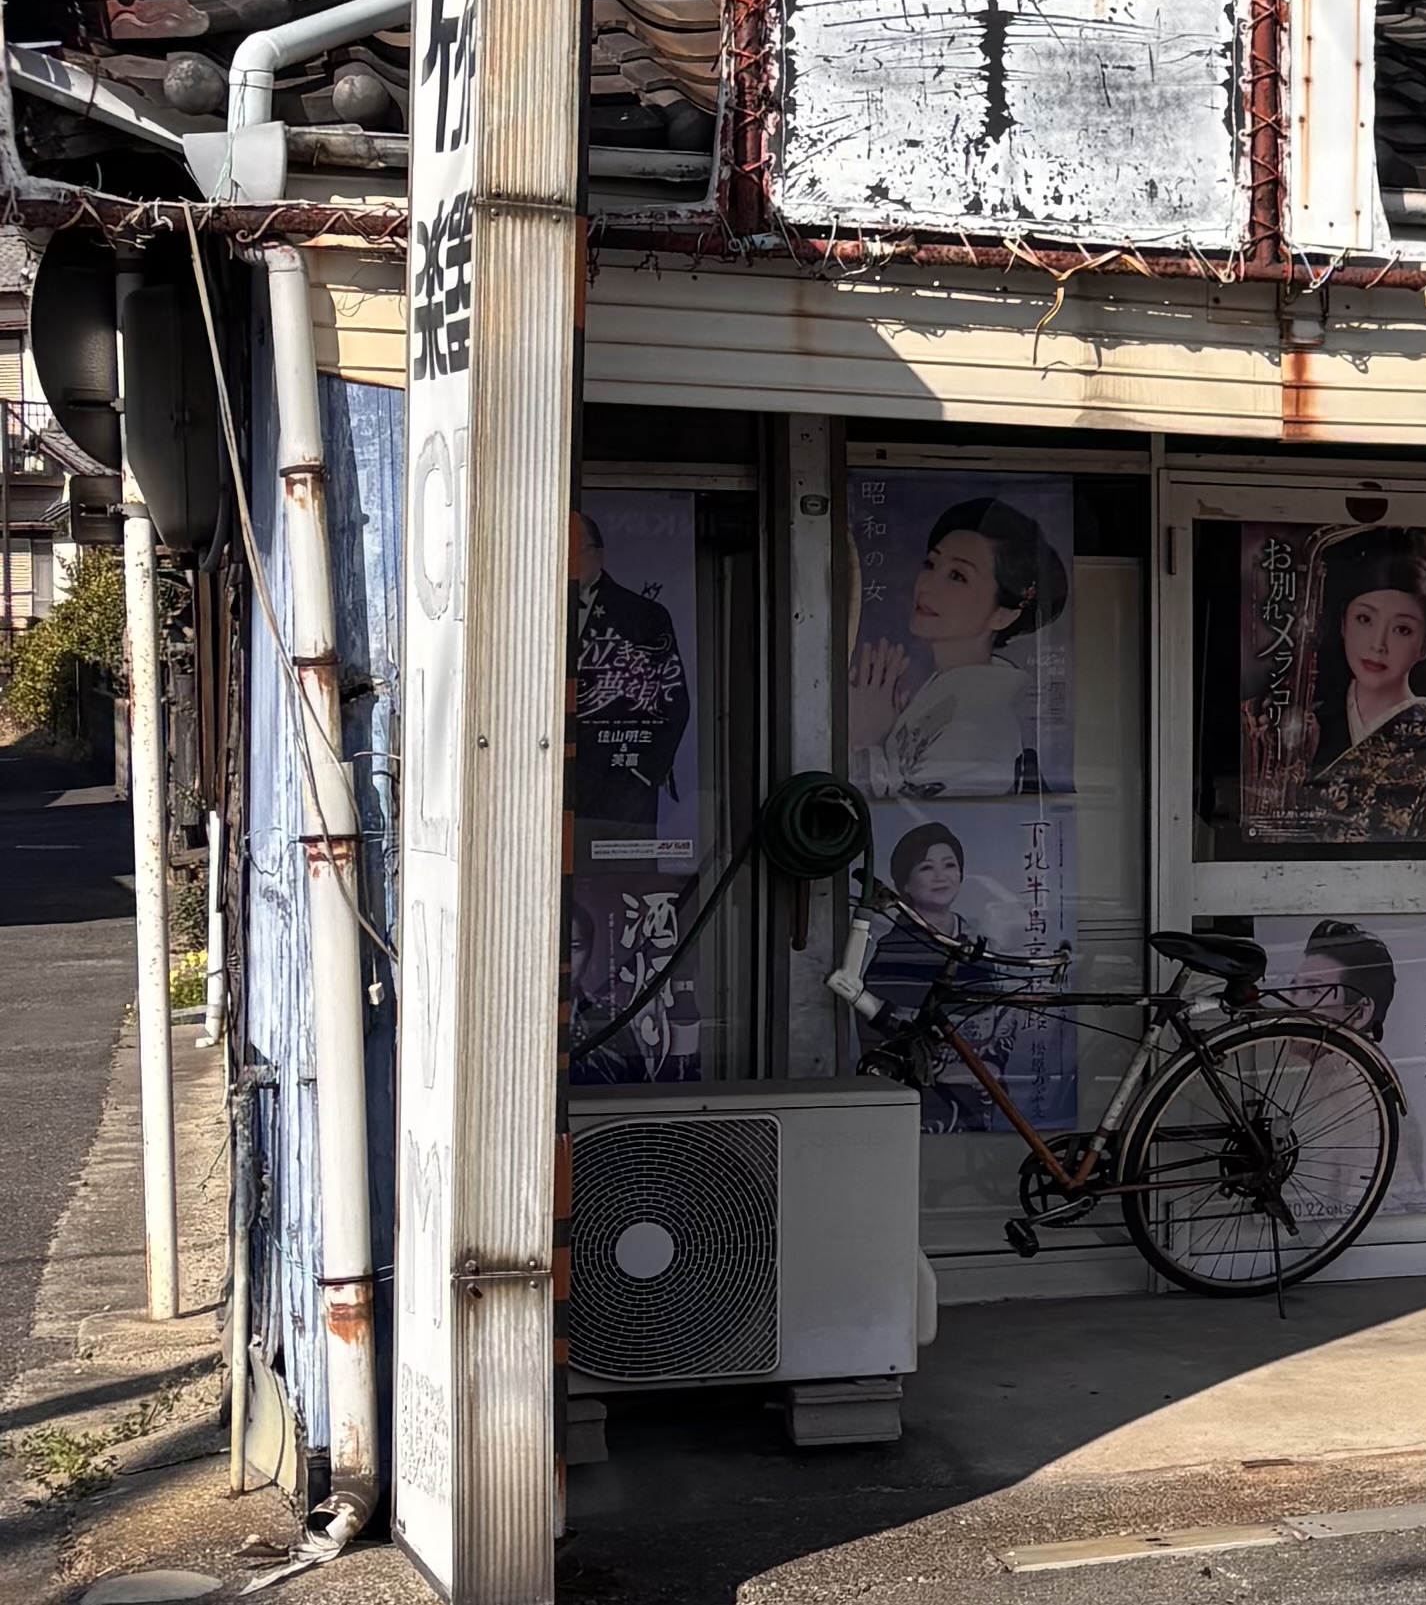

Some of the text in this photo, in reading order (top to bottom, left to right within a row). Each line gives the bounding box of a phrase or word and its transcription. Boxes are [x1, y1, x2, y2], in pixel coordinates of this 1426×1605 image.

[861, 481, 888, 603] 昭和の女
[1256, 538, 1297, 761] お別れメランコリー
